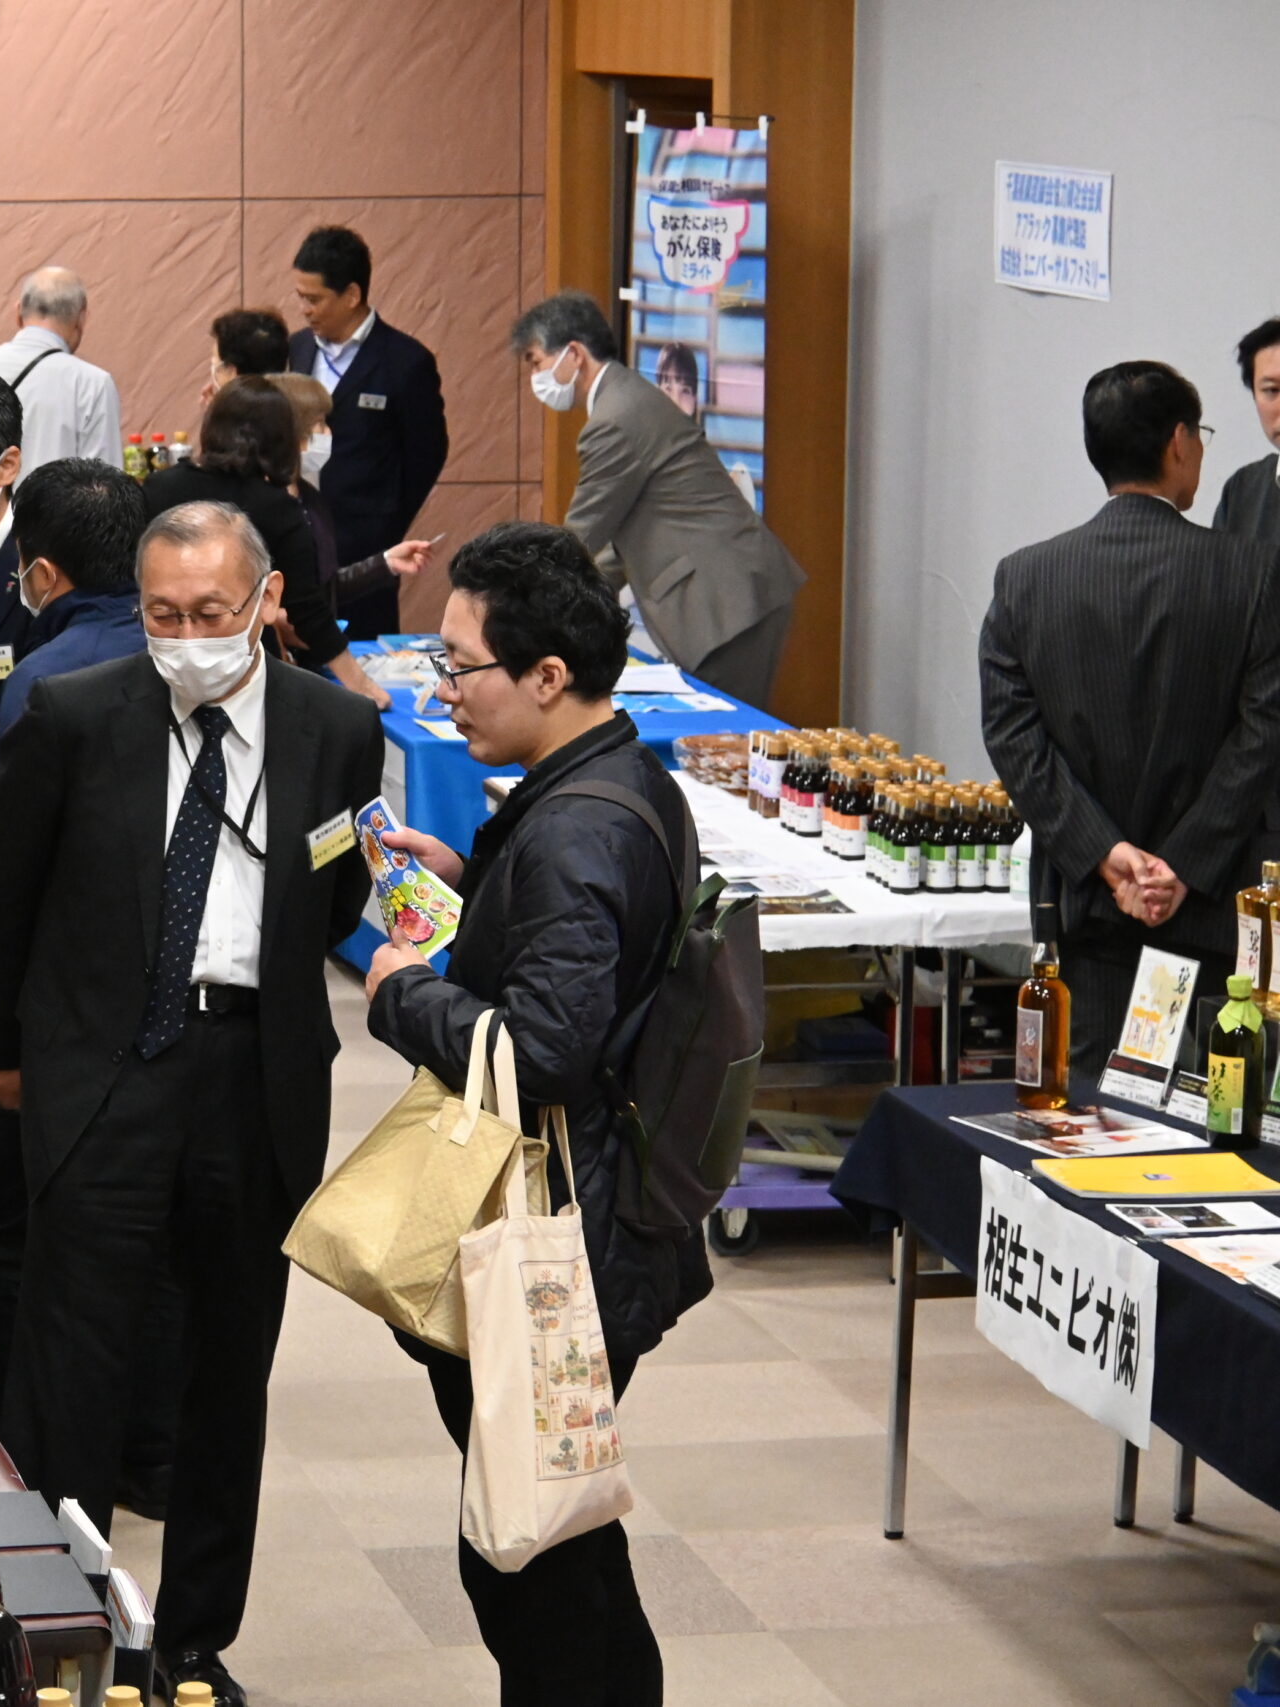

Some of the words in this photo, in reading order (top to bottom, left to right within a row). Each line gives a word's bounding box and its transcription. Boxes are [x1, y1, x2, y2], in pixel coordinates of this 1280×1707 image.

[661, 214, 728, 233] あなたによりそう
[667, 234, 722, 261] がん保険
[682, 262, 712, 279] ミライト
[1024, 252, 1107, 288] ユニバーサルファミリー
[984, 1207, 1140, 1394] 相生ユニビオ(株)
